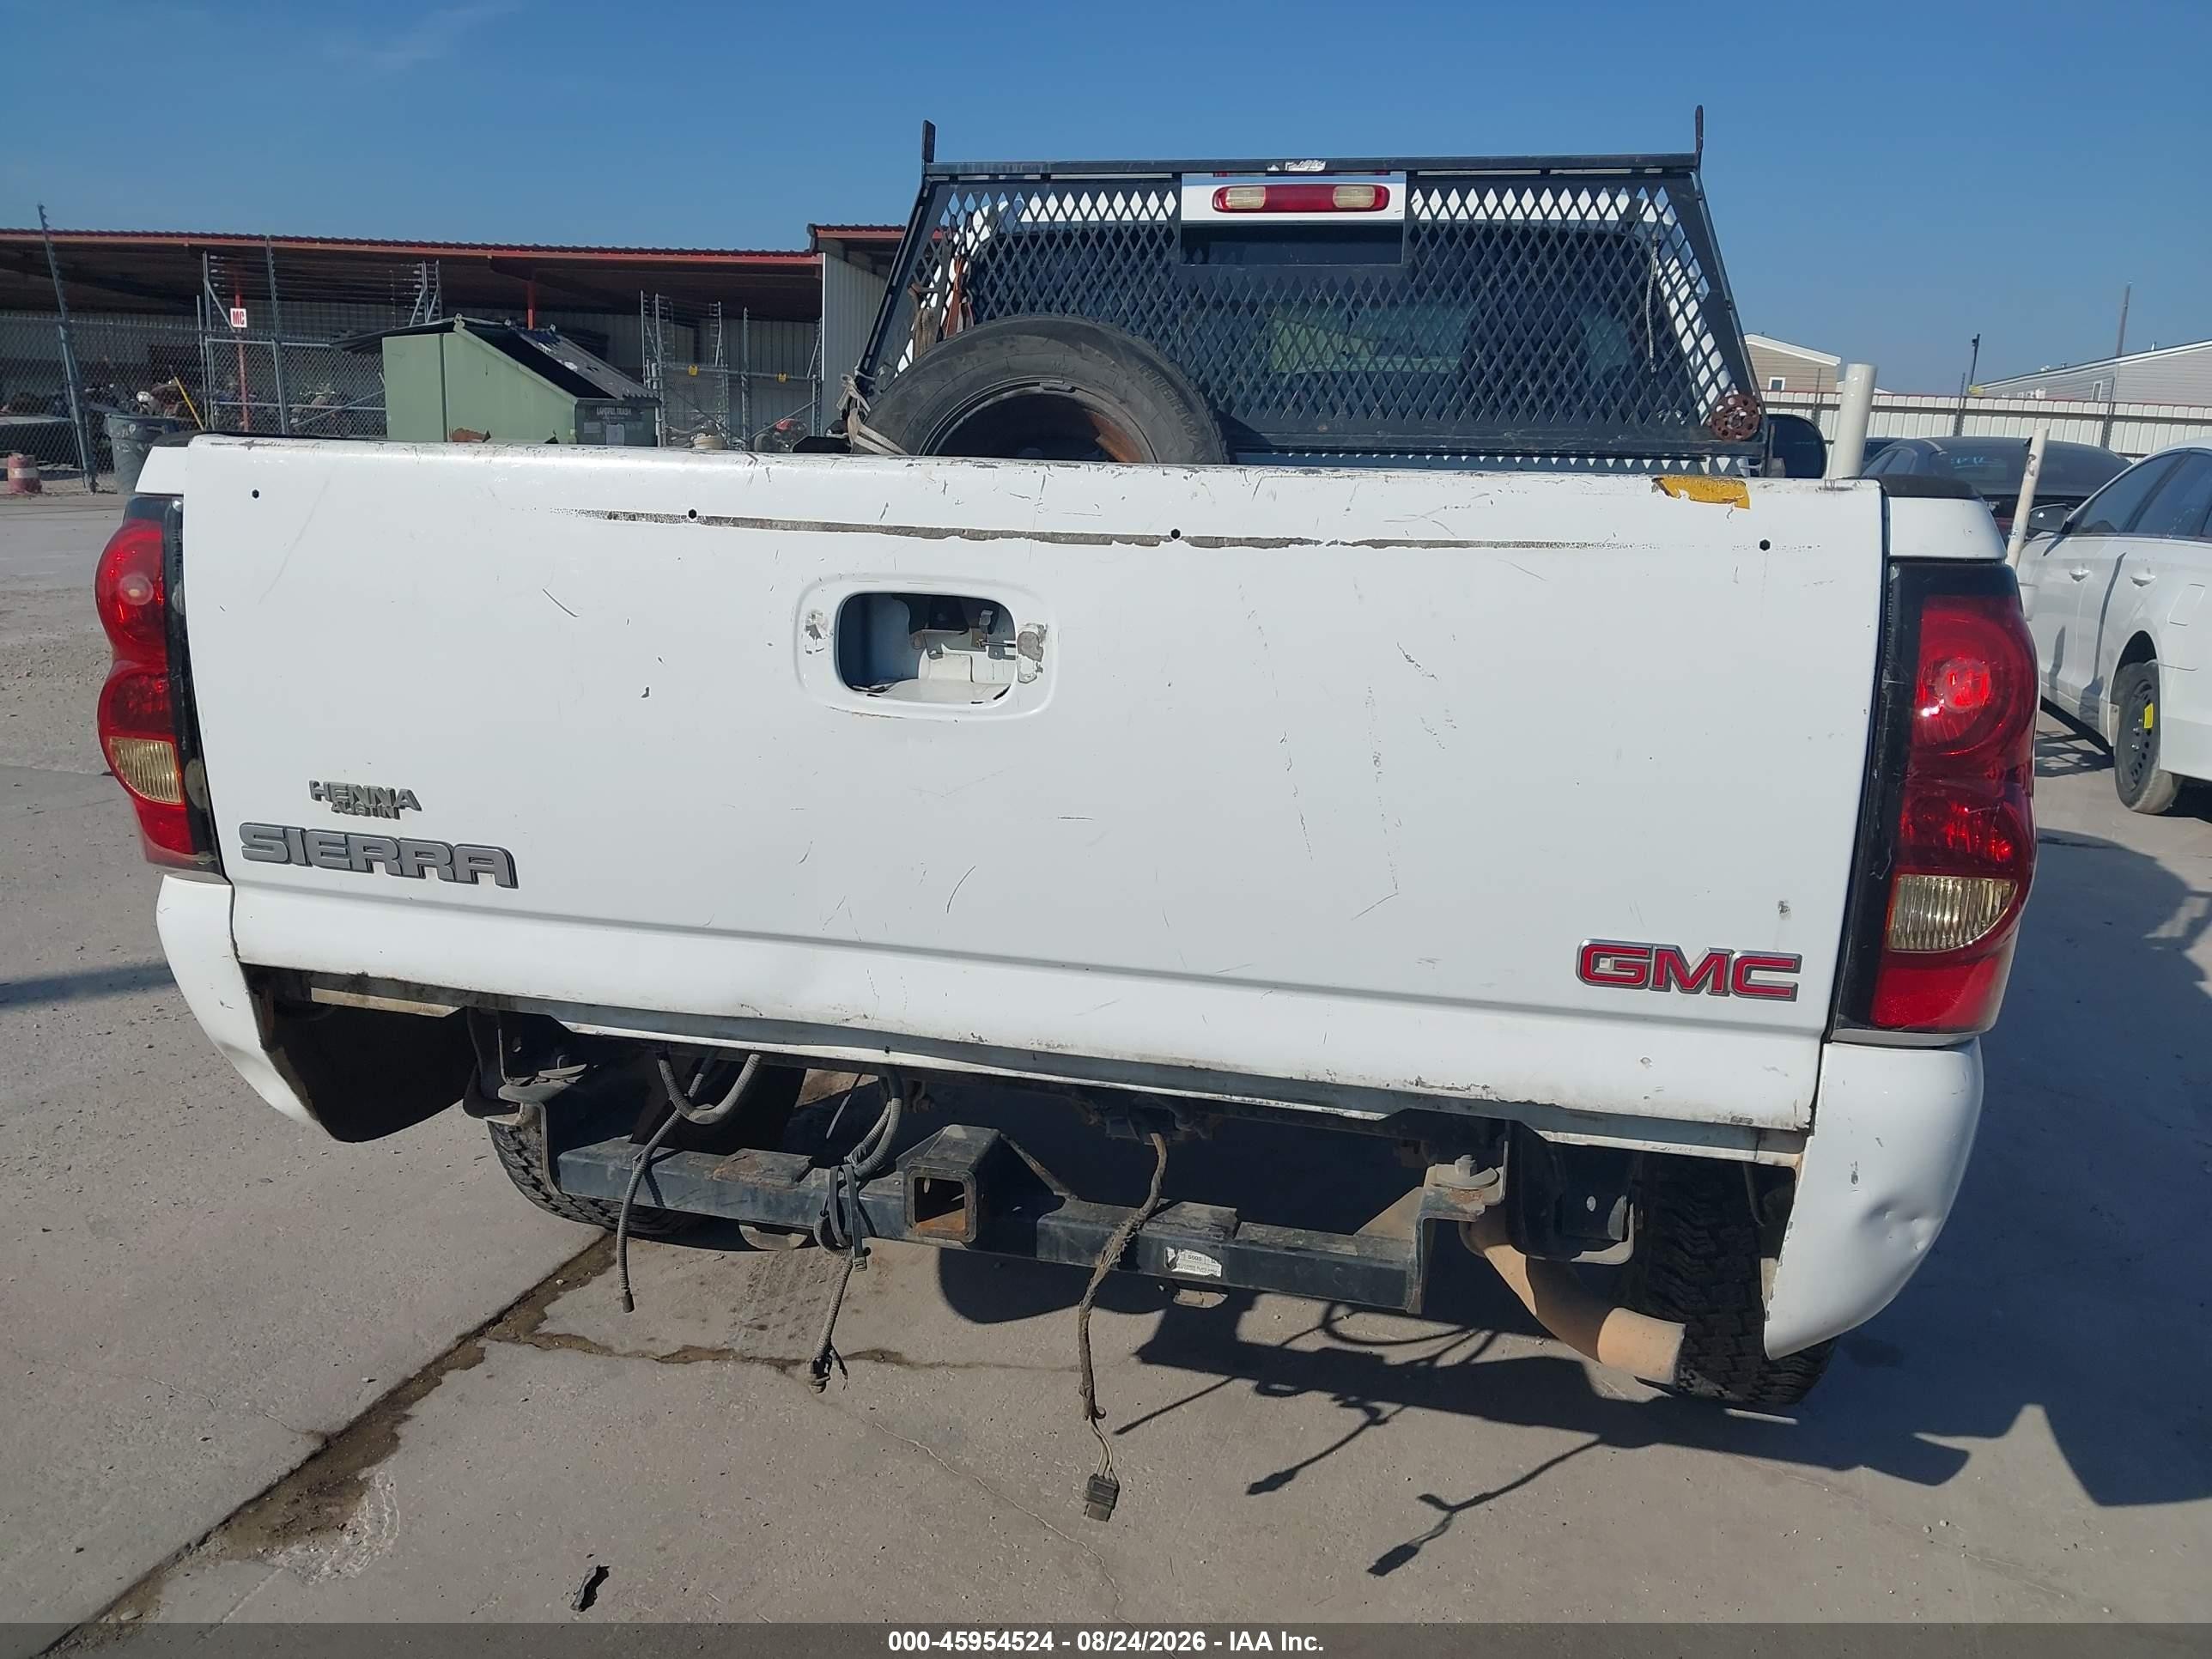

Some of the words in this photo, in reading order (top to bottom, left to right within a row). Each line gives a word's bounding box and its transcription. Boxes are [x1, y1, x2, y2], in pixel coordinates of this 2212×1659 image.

[233, 310, 245, 325] MC
[309, 781, 422, 811] HENNA
[239, 822, 519, 889] SIERRA
[1576, 939, 1802, 1002] GMC
